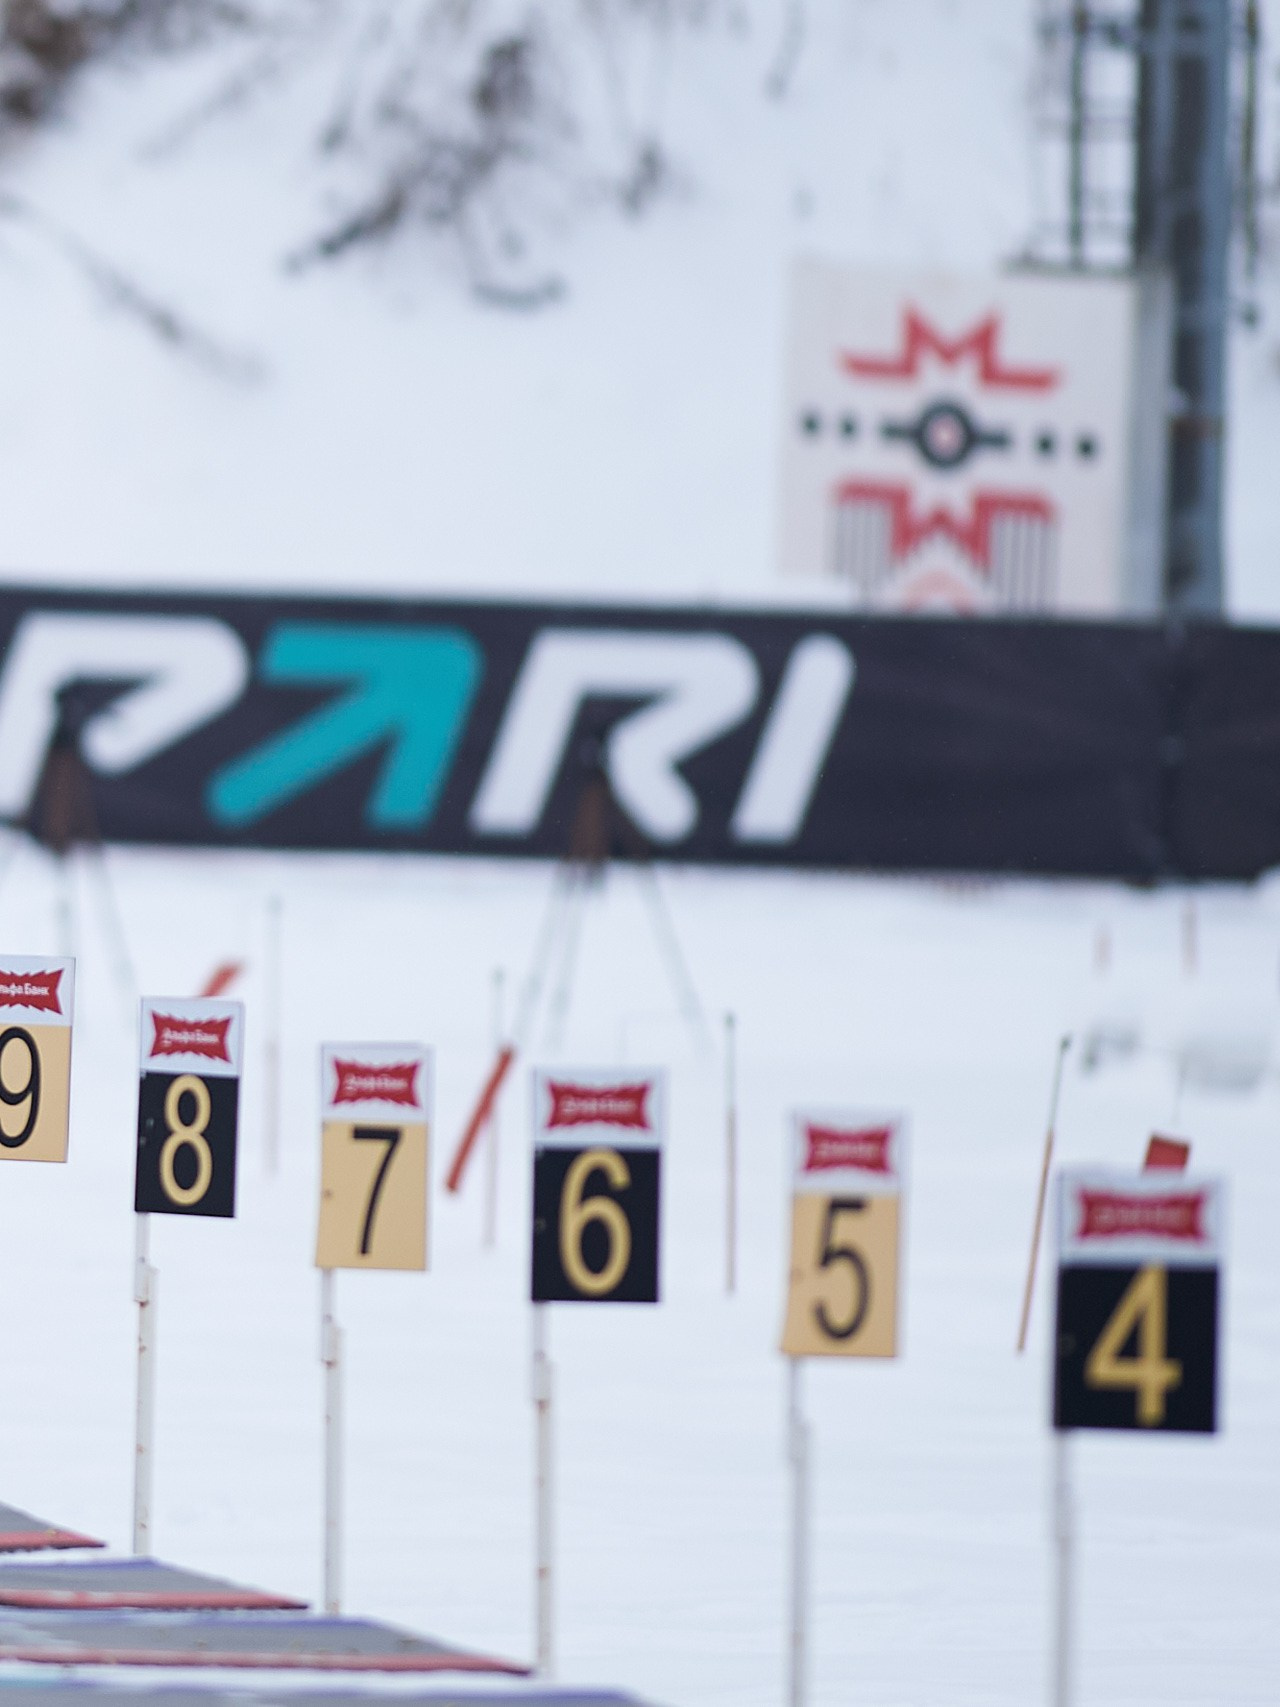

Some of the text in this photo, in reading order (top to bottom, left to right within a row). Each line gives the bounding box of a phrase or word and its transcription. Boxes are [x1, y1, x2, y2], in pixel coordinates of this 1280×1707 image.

[159, 1073, 213, 1207] 8
[352, 1126, 403, 1255] 7
[558, 1147, 632, 1297] 6
[813, 1196, 872, 1341] 5
[1082, 1260, 1184, 1427] 4
